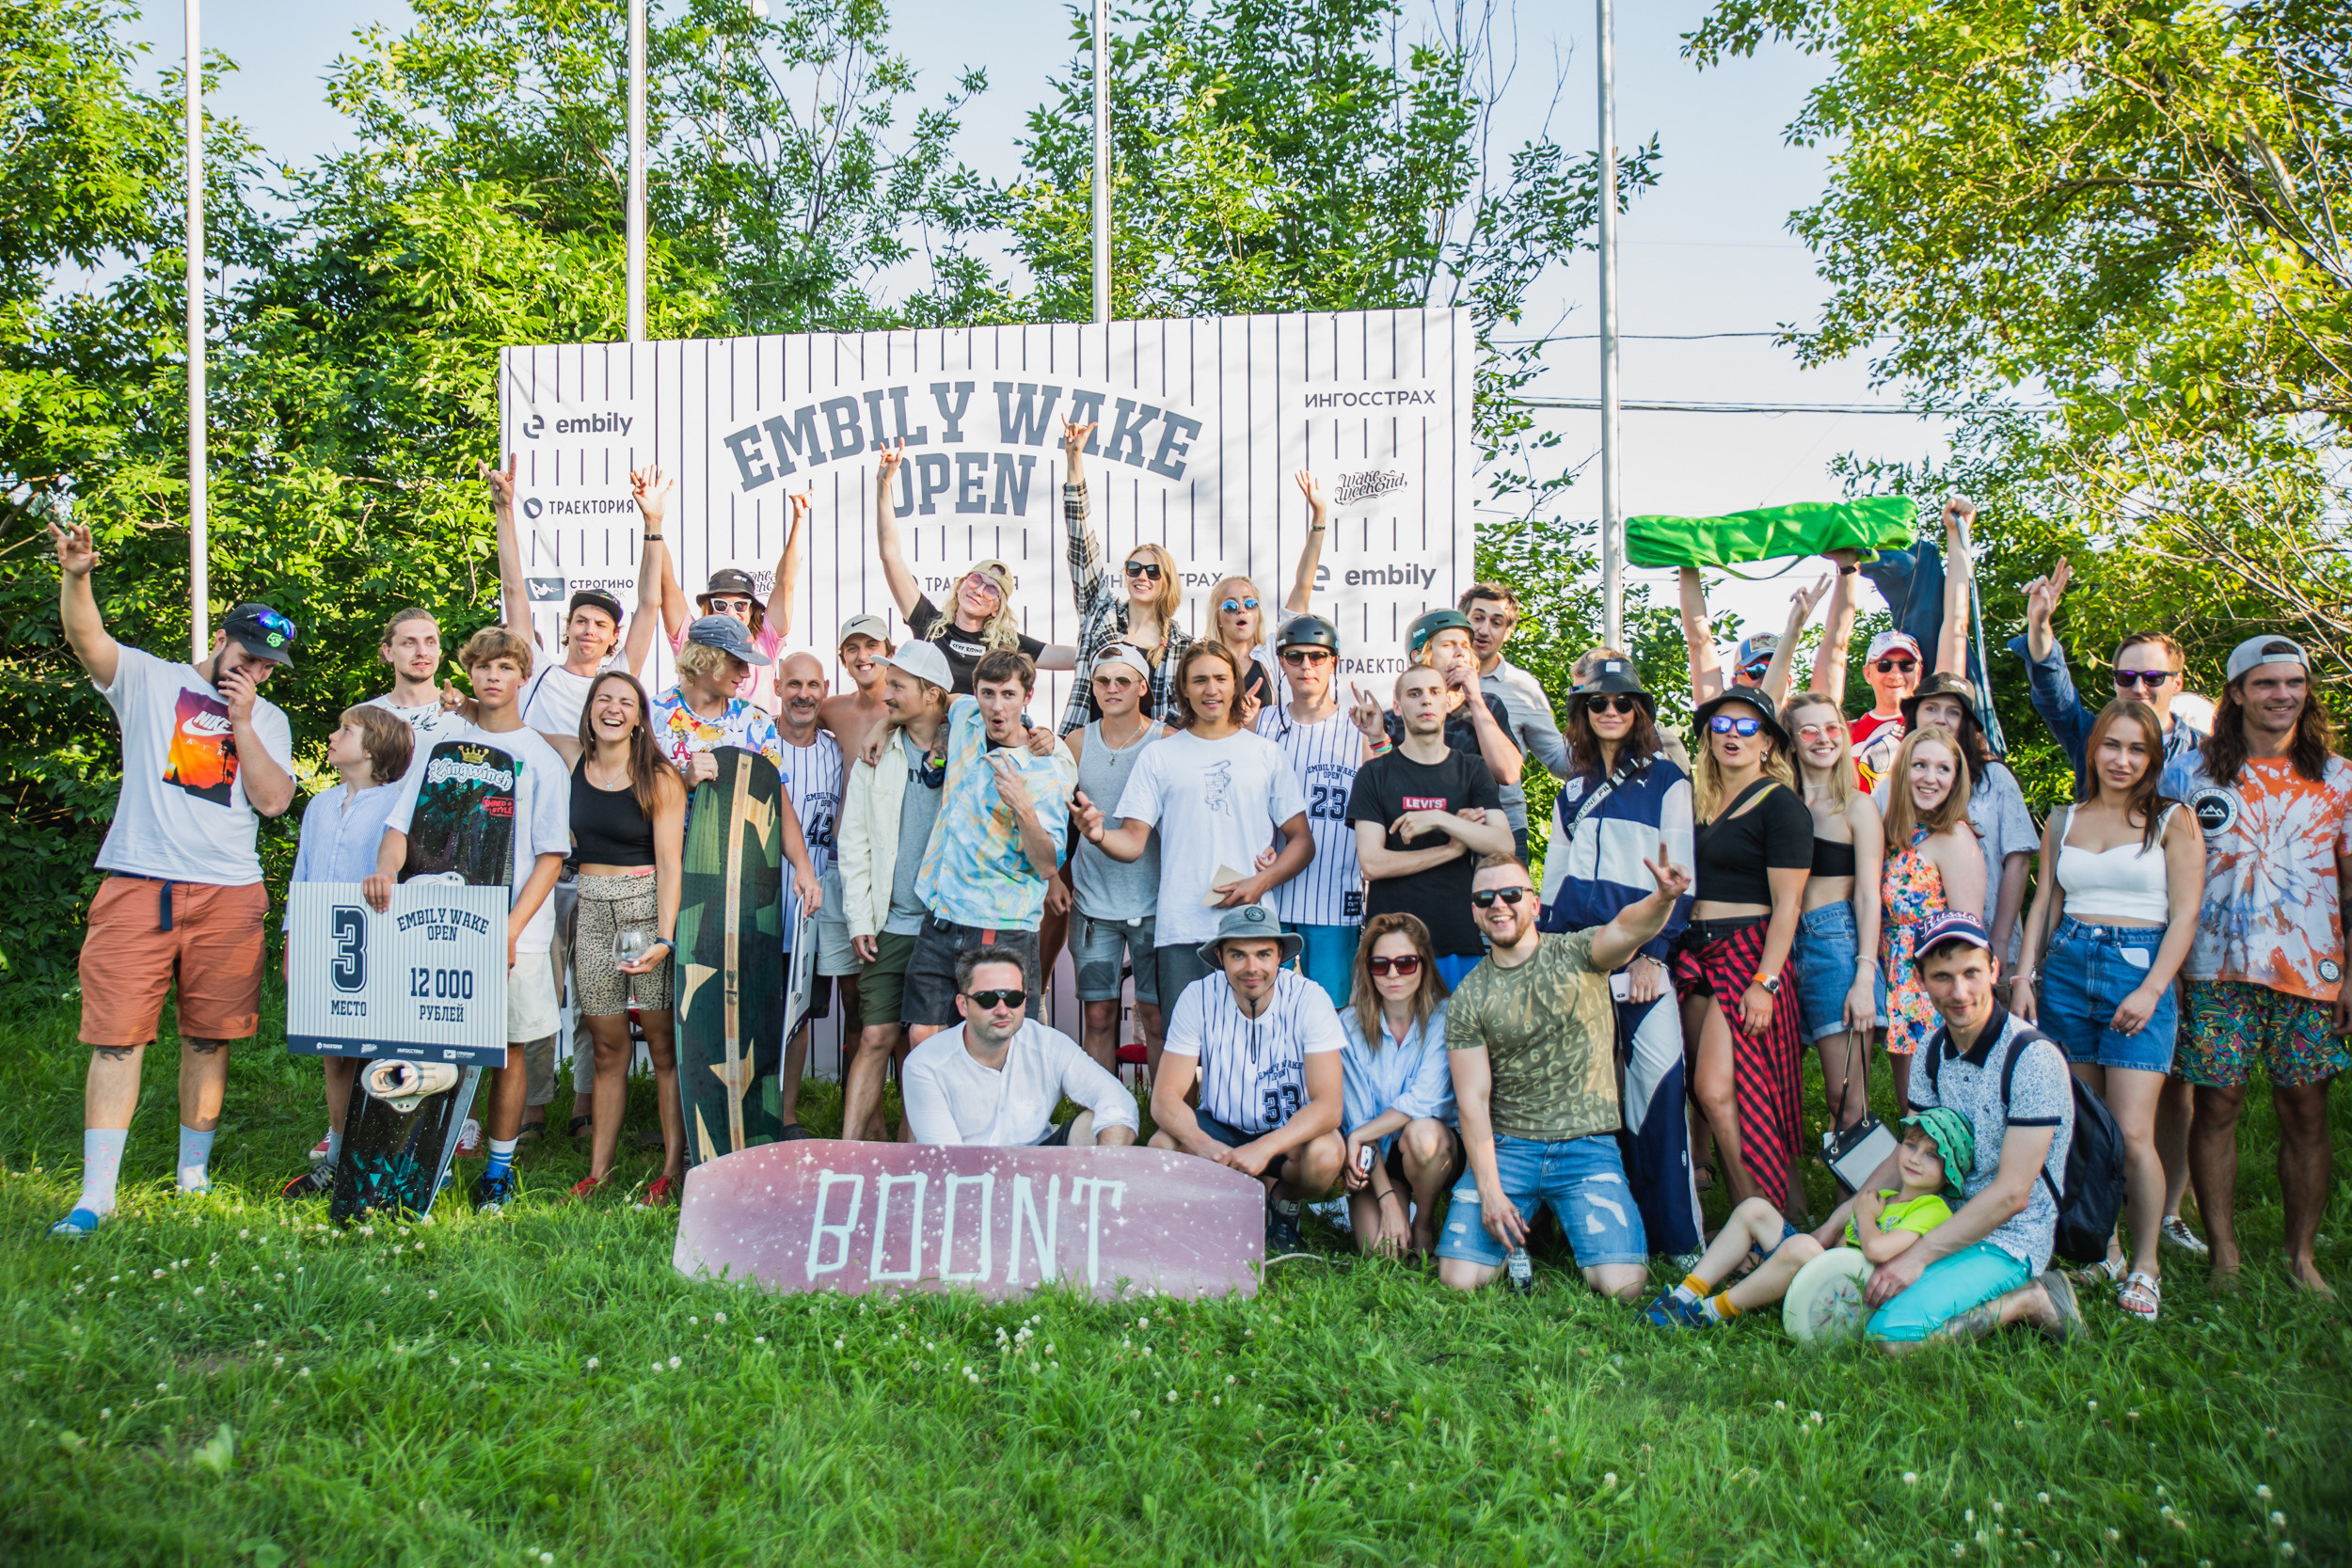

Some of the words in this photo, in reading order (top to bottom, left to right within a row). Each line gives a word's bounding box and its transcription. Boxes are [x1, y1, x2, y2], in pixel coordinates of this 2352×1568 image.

[1305, 389, 1437, 408] ИНГОССТРАХ
[555, 412, 634, 437] embily
[723, 381, 975, 490] EMBILY
[993, 381, 1203, 482] WAKE
[890, 451, 1038, 518] OPEN
[548, 499, 634, 515] ТРАЕКТОРИЯ
[569, 578, 634, 590] СТРОГИНО
[1344, 563, 1437, 590] embily
[1338, 658, 1407, 674] ТРАЕКТО
[193, 710, 232, 731] NIKE
[428, 758, 513, 791] Kingwinch
[1307, 764, 1335, 774] EMBILY
[1323, 771, 1341, 780] OPEN
[492, 806, 513, 815] STYLE
[1309, 784, 1349, 821] 23
[805, 812, 834, 849] 42
[396, 908, 447, 932] EMBILY
[450, 909, 490, 935] WAKE
[427, 925, 458, 942] OPEN
[331, 904, 369, 993] 3
[410, 967, 430, 997] 12
[436, 968, 473, 1000] 000
[330, 999, 367, 1017] МЕСТО
[419, 1003, 465, 1022] РУБЛЕЙ
[1263, 1082, 1302, 1125] 33
[806, 1169, 1126, 1288] BOONT
